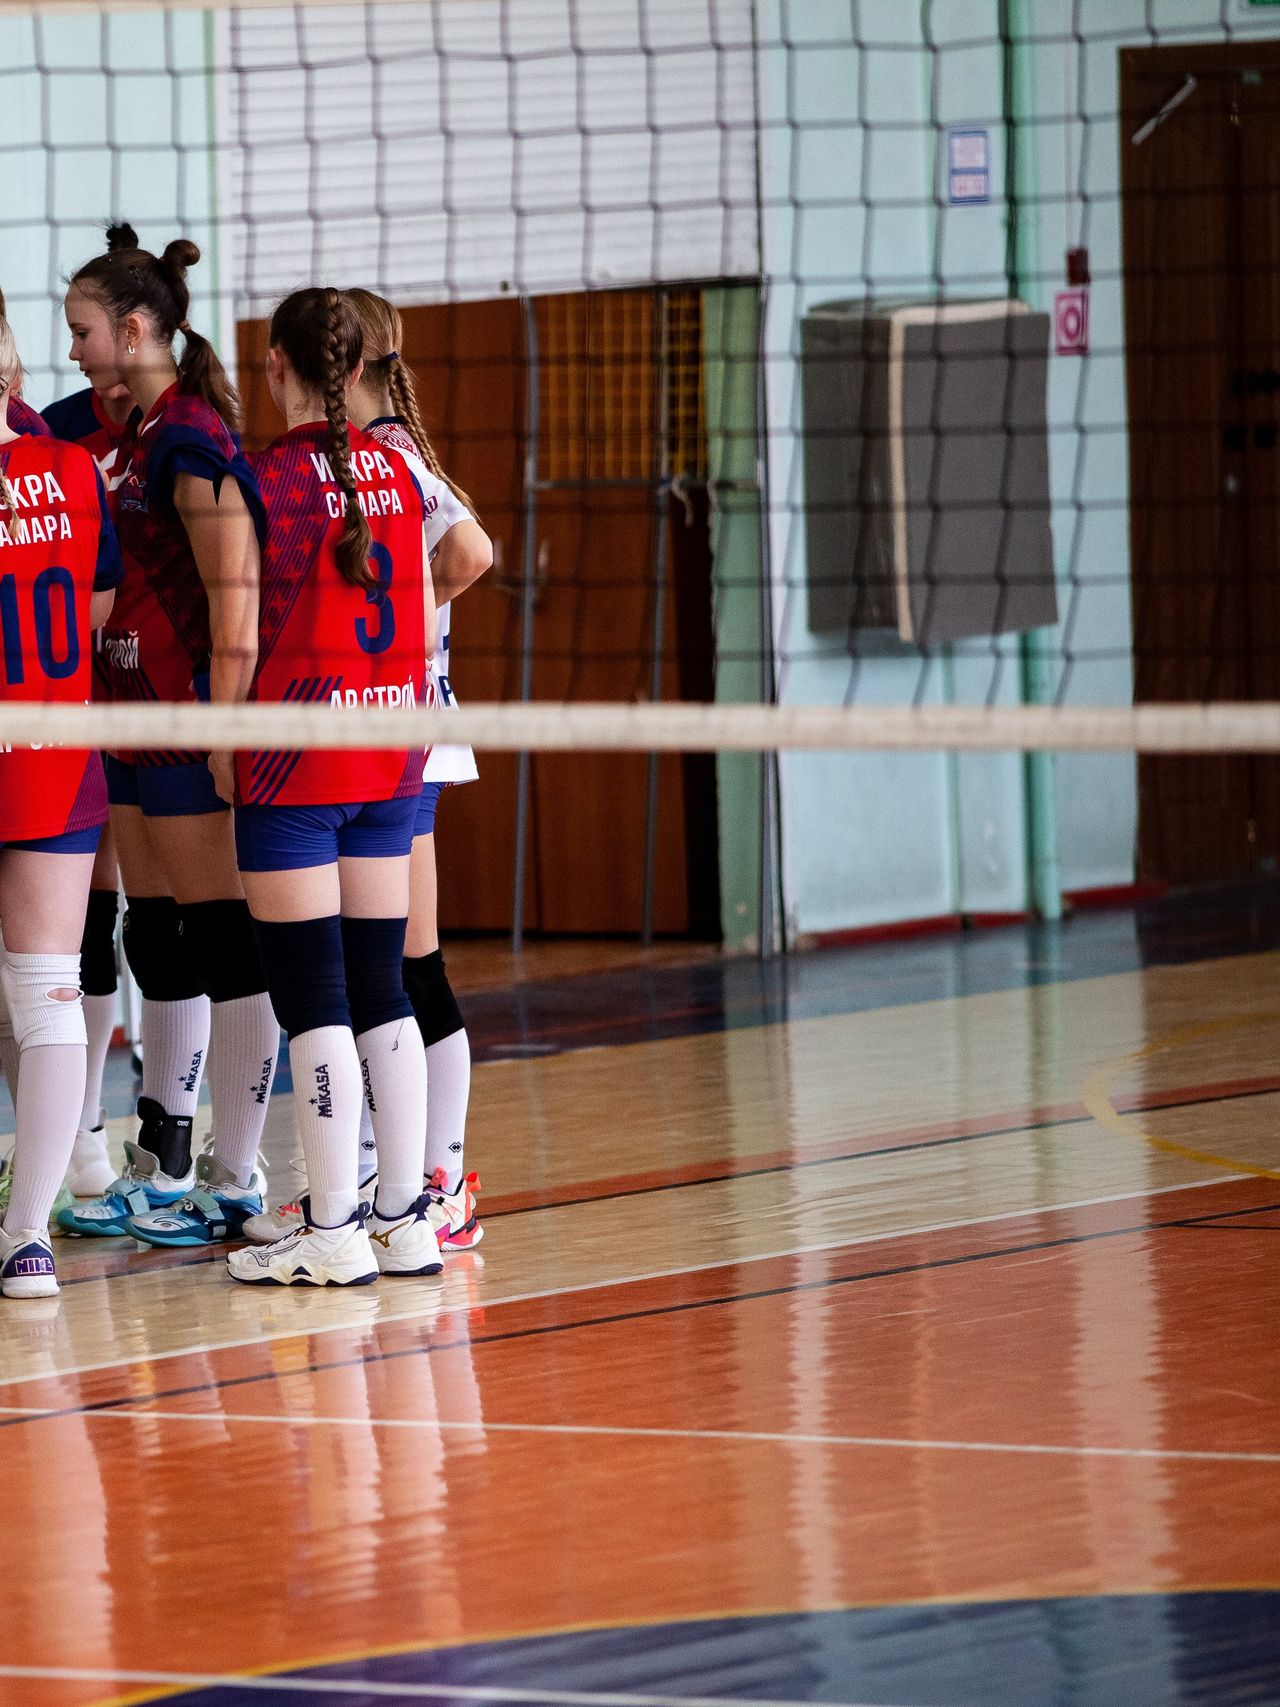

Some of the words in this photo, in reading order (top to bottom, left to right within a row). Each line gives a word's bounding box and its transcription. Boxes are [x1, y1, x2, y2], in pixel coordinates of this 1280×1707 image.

[310, 450, 395, 482] ИКРА
[354, 542, 396, 654] 3
[184, 1050, 203, 1092] MIKASA
[255, 1057, 273, 1104] MIKASA
[314, 1063, 333, 1118] MIKASA
[361, 1058, 377, 1112] MIKASA
[15, 1257, 54, 1276] NIKE
